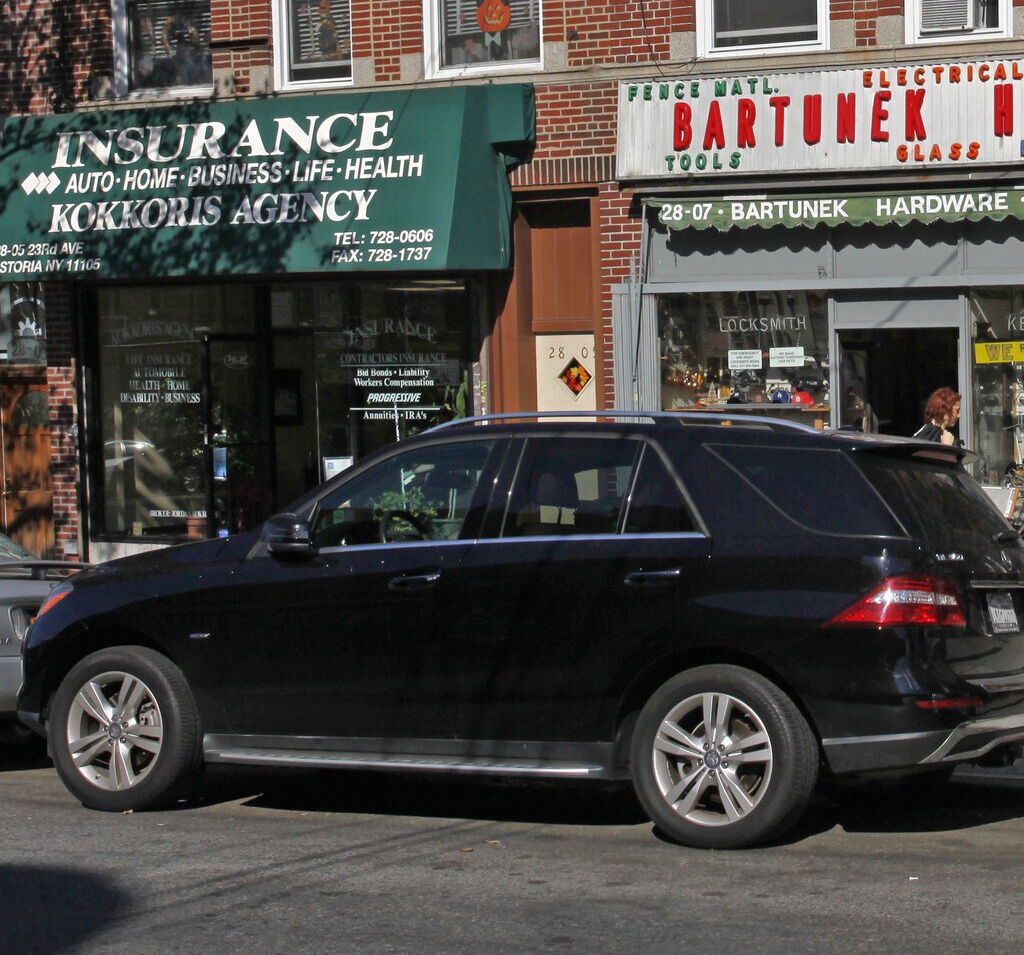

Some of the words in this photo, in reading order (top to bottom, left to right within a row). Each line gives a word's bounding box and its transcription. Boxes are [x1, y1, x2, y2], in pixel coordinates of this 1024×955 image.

[862, 62, 1024, 89] ELECTRICAL
[628, 80, 700, 102] FENCE
[714, 77, 779, 97] MATL.
[672, 88, 927, 152] BARTUNEK
[51, 110, 394, 169] INSURANCE
[896, 141, 981, 163] GLASS
[665, 151, 742, 172] TOOLS
[65, 172, 114, 194] AUTO
[123, 166, 180, 191] HOME
[188, 161, 282, 188] BUSINESS
[292, 158, 334, 183] LIFE
[344, 154, 424, 180] HEALTH
[48, 194, 222, 233] KOKKORIS
[229, 189, 378, 225] AGENCY
[661, 202, 713, 221] 28-07
[730, 199, 849, 221] BARTUNEK
[876, 192, 1009, 217] HARDWARE
[333, 232, 365, 246] TEL:
[370, 229, 434, 244] 728-0606
[0, 243, 25, 256] 8-05
[27, 243, 57, 256] 23Rd
[60, 242, 84, 255] AVE
[331, 249, 363, 264] FAX:
[367, 247, 432, 263] 728-1737
[0, 259, 42, 273] STORIA
[45, 259, 65, 272] NY
[66, 258, 101, 272] 11105
[719, 316, 807, 333] LOCKSMITH
[340, 353, 398, 363] CONTRACTORS
[400, 352, 446, 363] INSURANCE
[985, 344, 1014, 361] WE
[357, 368, 369, 376] Bid
[370, 368, 393, 376] Bonds
[398, 368, 430, 378] Liability
[354, 378, 383, 387] Workers
[384, 377, 434, 388] Compensation
[164, 392, 200, 403] BUSINESS
[366, 393, 422, 403] PROGRESSIVE
[405, 411, 427, 420] IRA's
